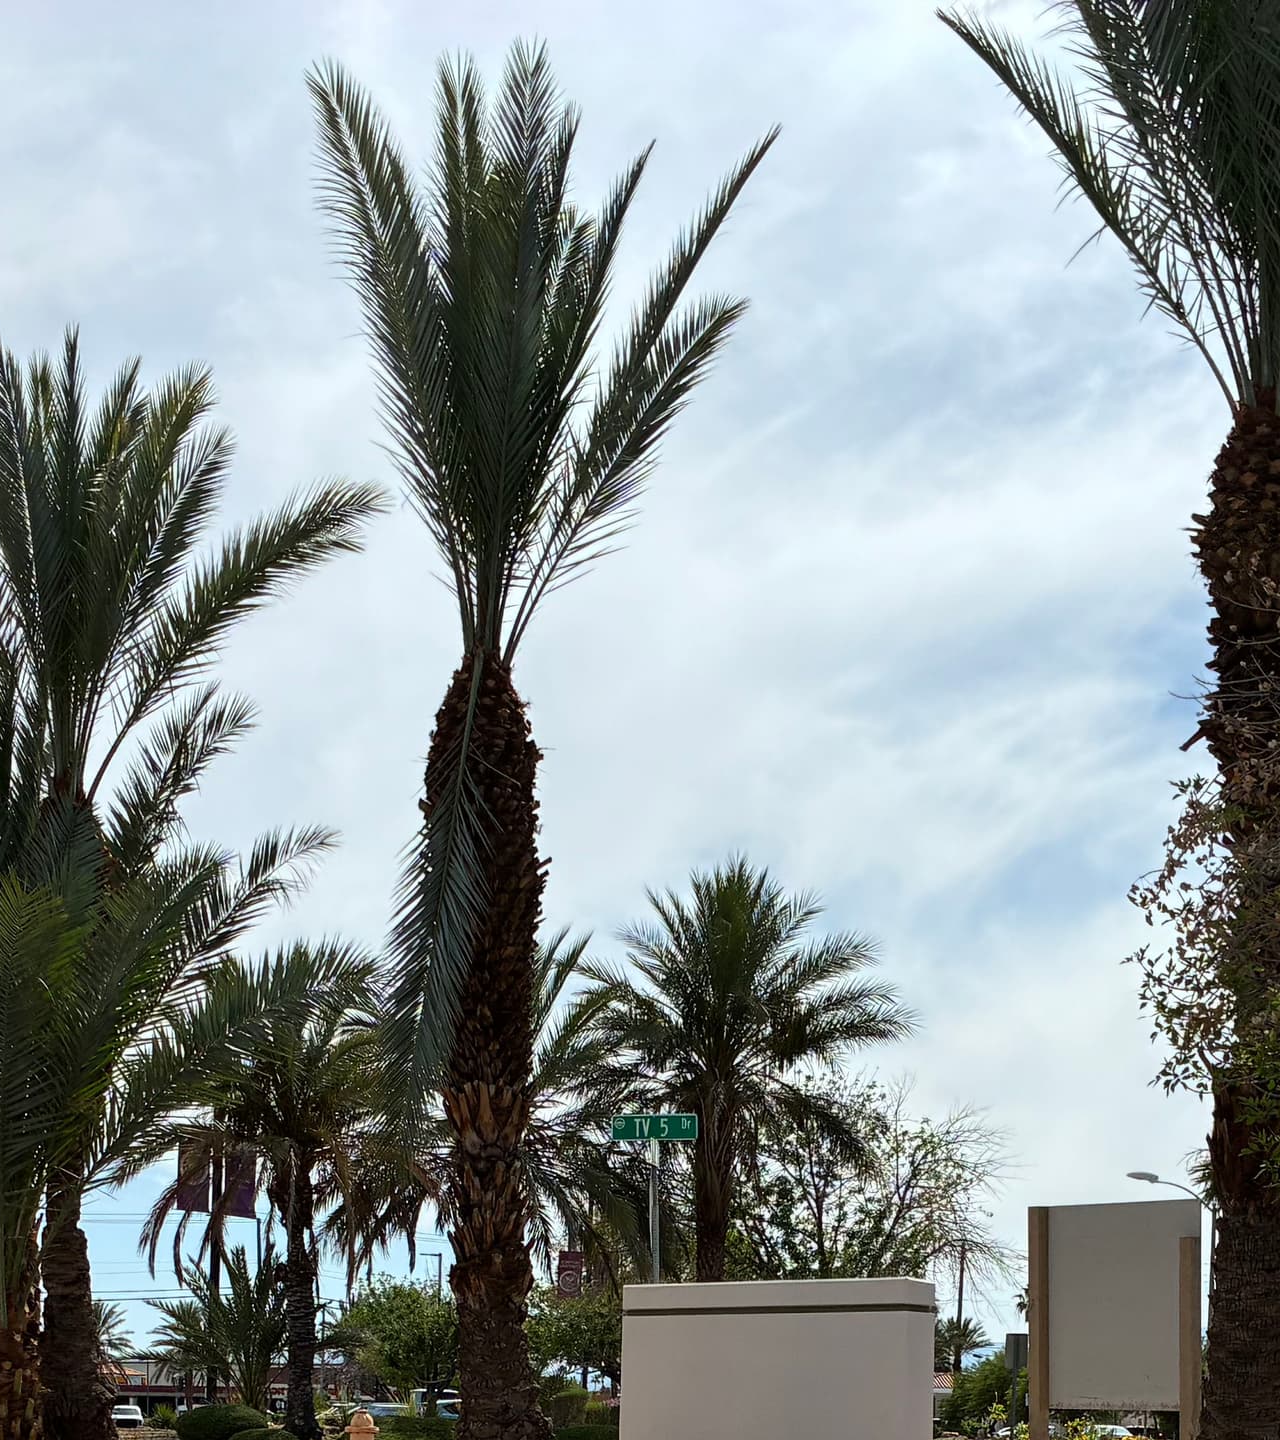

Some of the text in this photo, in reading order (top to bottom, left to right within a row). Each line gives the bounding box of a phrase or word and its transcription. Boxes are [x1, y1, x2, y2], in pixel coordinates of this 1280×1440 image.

[634, 1117, 692, 1138] TV 5 Dr
